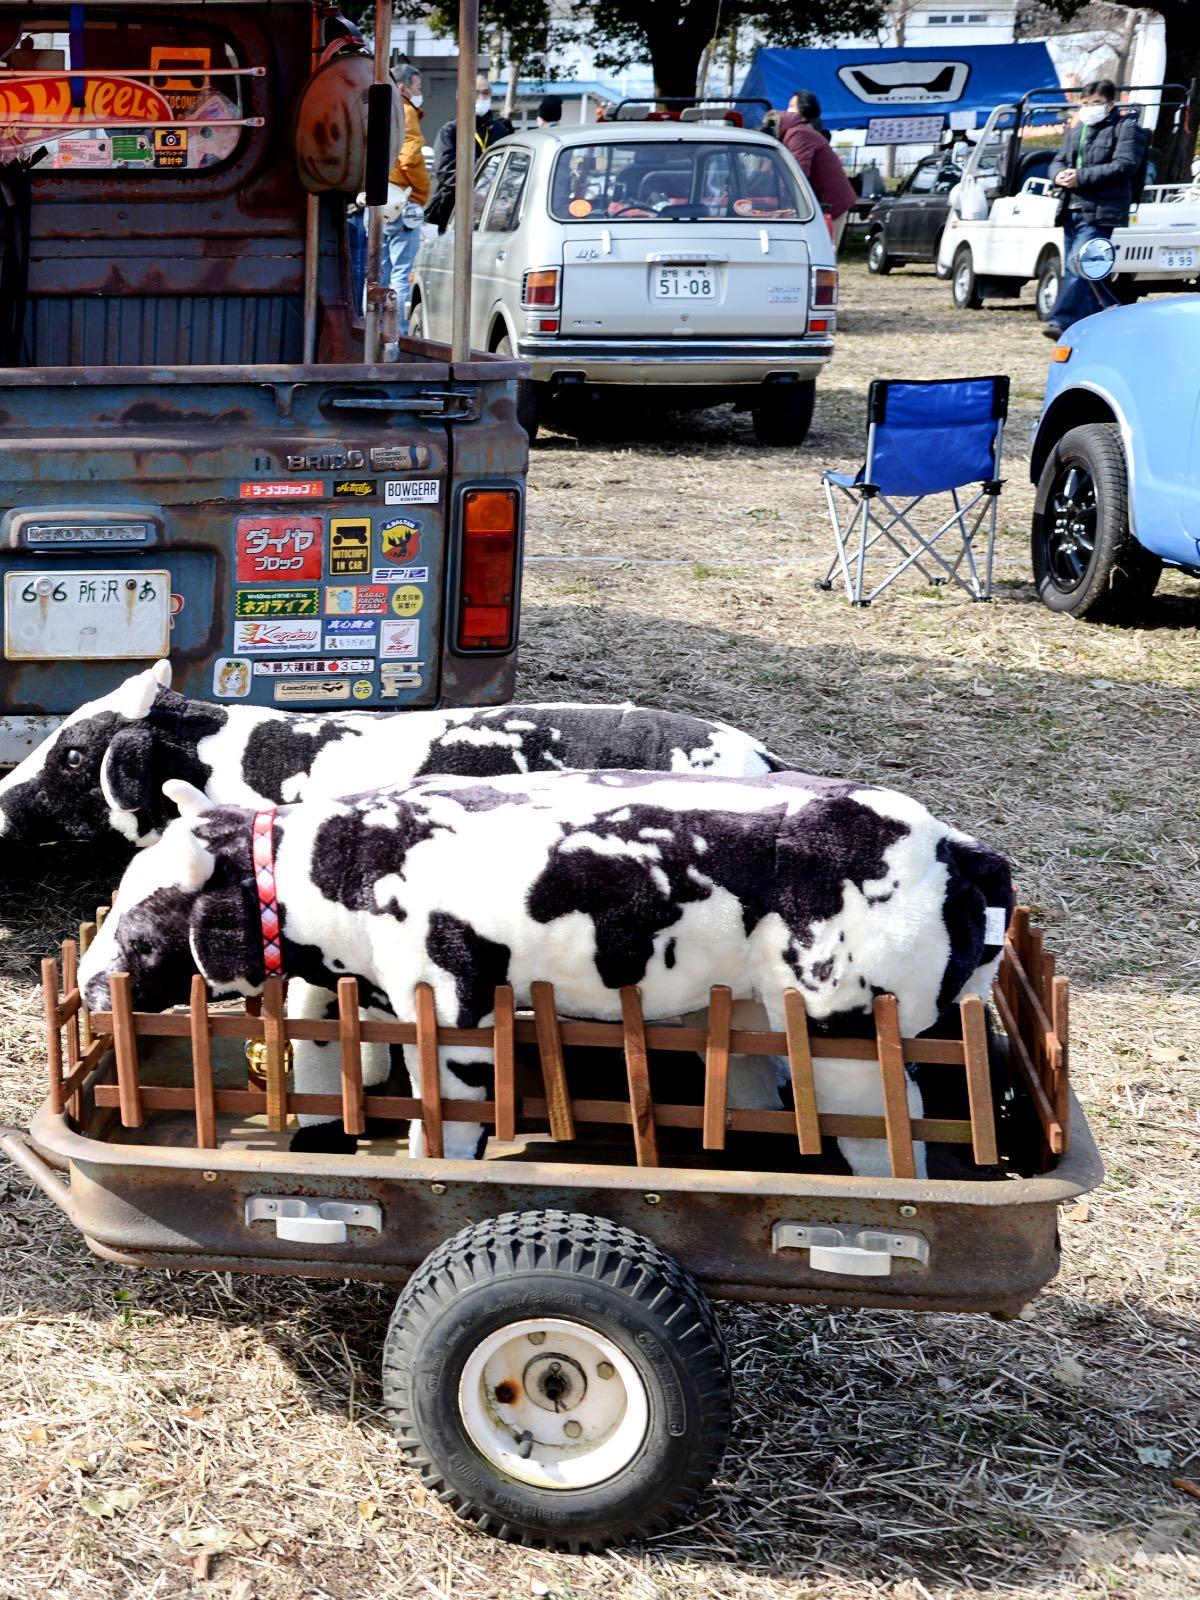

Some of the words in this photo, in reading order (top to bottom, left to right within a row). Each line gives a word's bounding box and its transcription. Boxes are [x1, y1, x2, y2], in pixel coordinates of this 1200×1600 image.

[660, 279, 711, 295] 51-08
[388, 482, 437, 497] BOWGEAR
[39, 528, 137, 540] HONDA
[244, 528, 314, 554] ダイヤ
[254, 556, 304, 571] ブロック
[336, 561, 346, 570] IN
[348, 560, 363, 570] CAR
[77, 579, 121, 603] 所沢
[138, 580, 156, 601] あ
[242, 599, 312, 613] ネオライフ
[272, 661, 325, 673] 最大積載量
